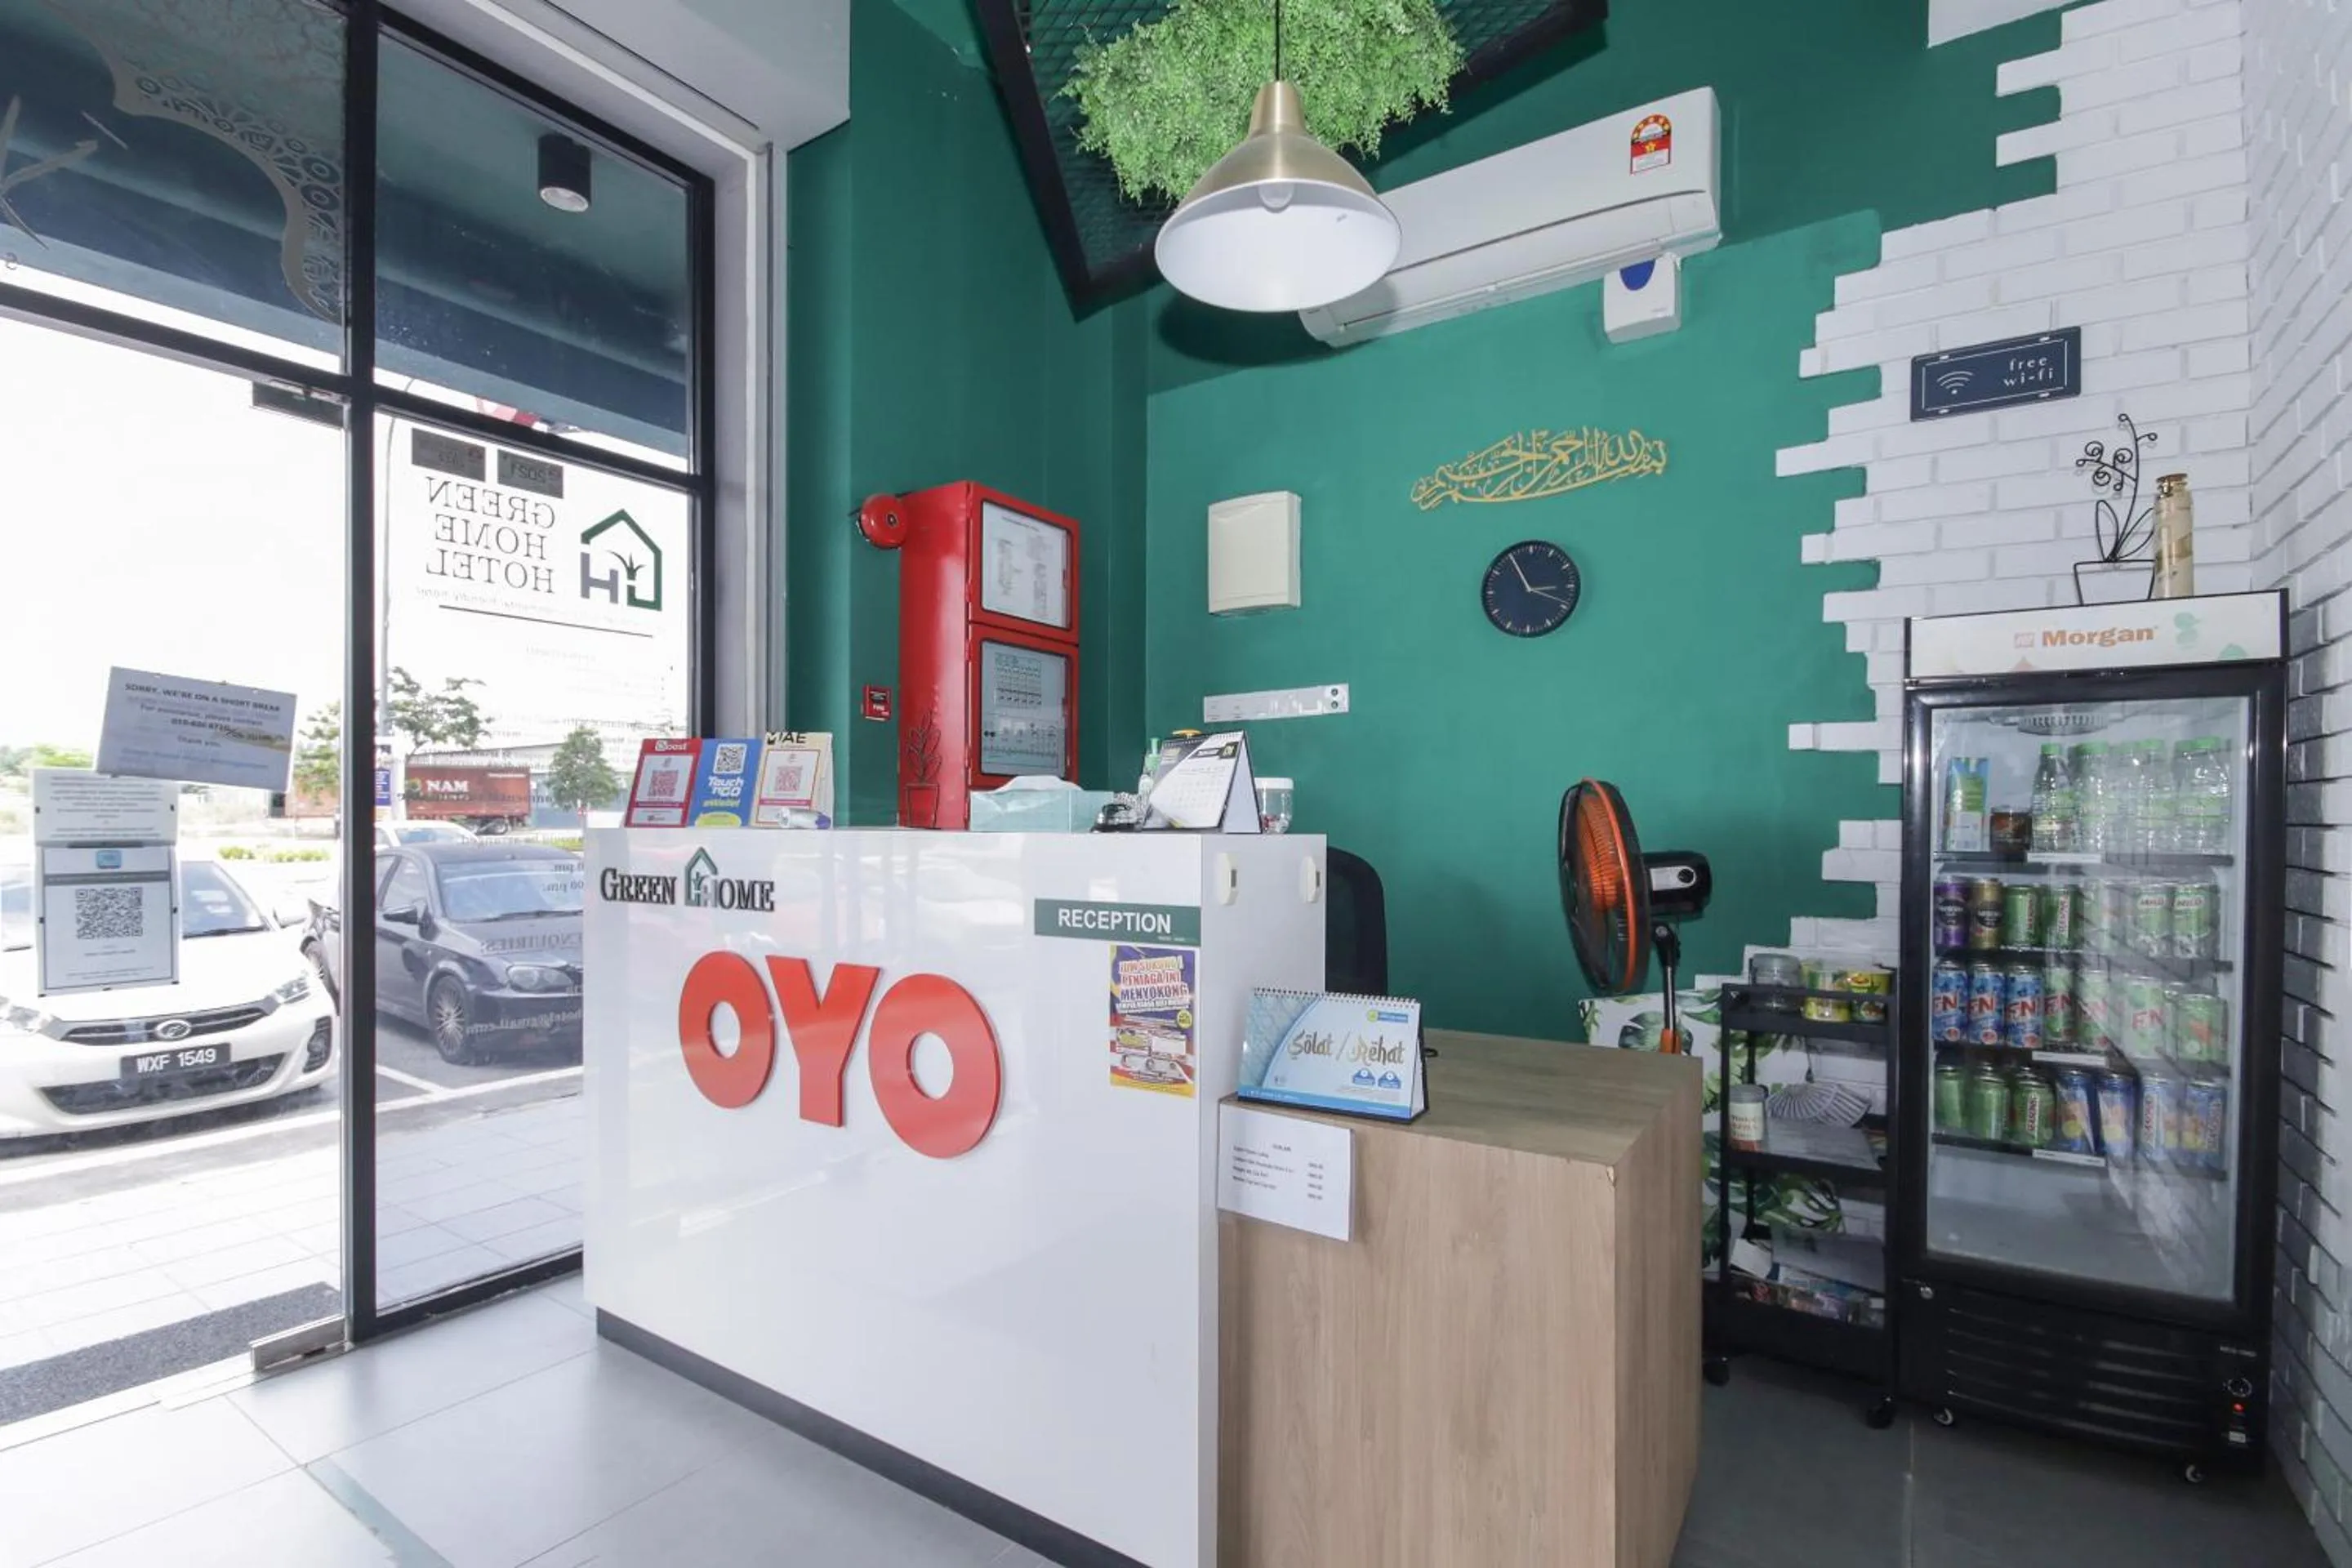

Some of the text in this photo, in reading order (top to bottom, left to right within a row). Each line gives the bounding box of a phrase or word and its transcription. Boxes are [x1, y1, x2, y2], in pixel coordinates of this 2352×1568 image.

[2009, 356, 2047, 371] free
[2003, 368, 2053, 386] wi-fi
[2042, 626, 2154, 648] Morgan
[426, 780, 470, 792] NAM
[600, 867, 677, 905] GREEN
[1058, 908, 1171, 934] RECEPTION
[137, 1049, 216, 1074] WXF 1549
[679, 950, 1003, 1159] OYO
